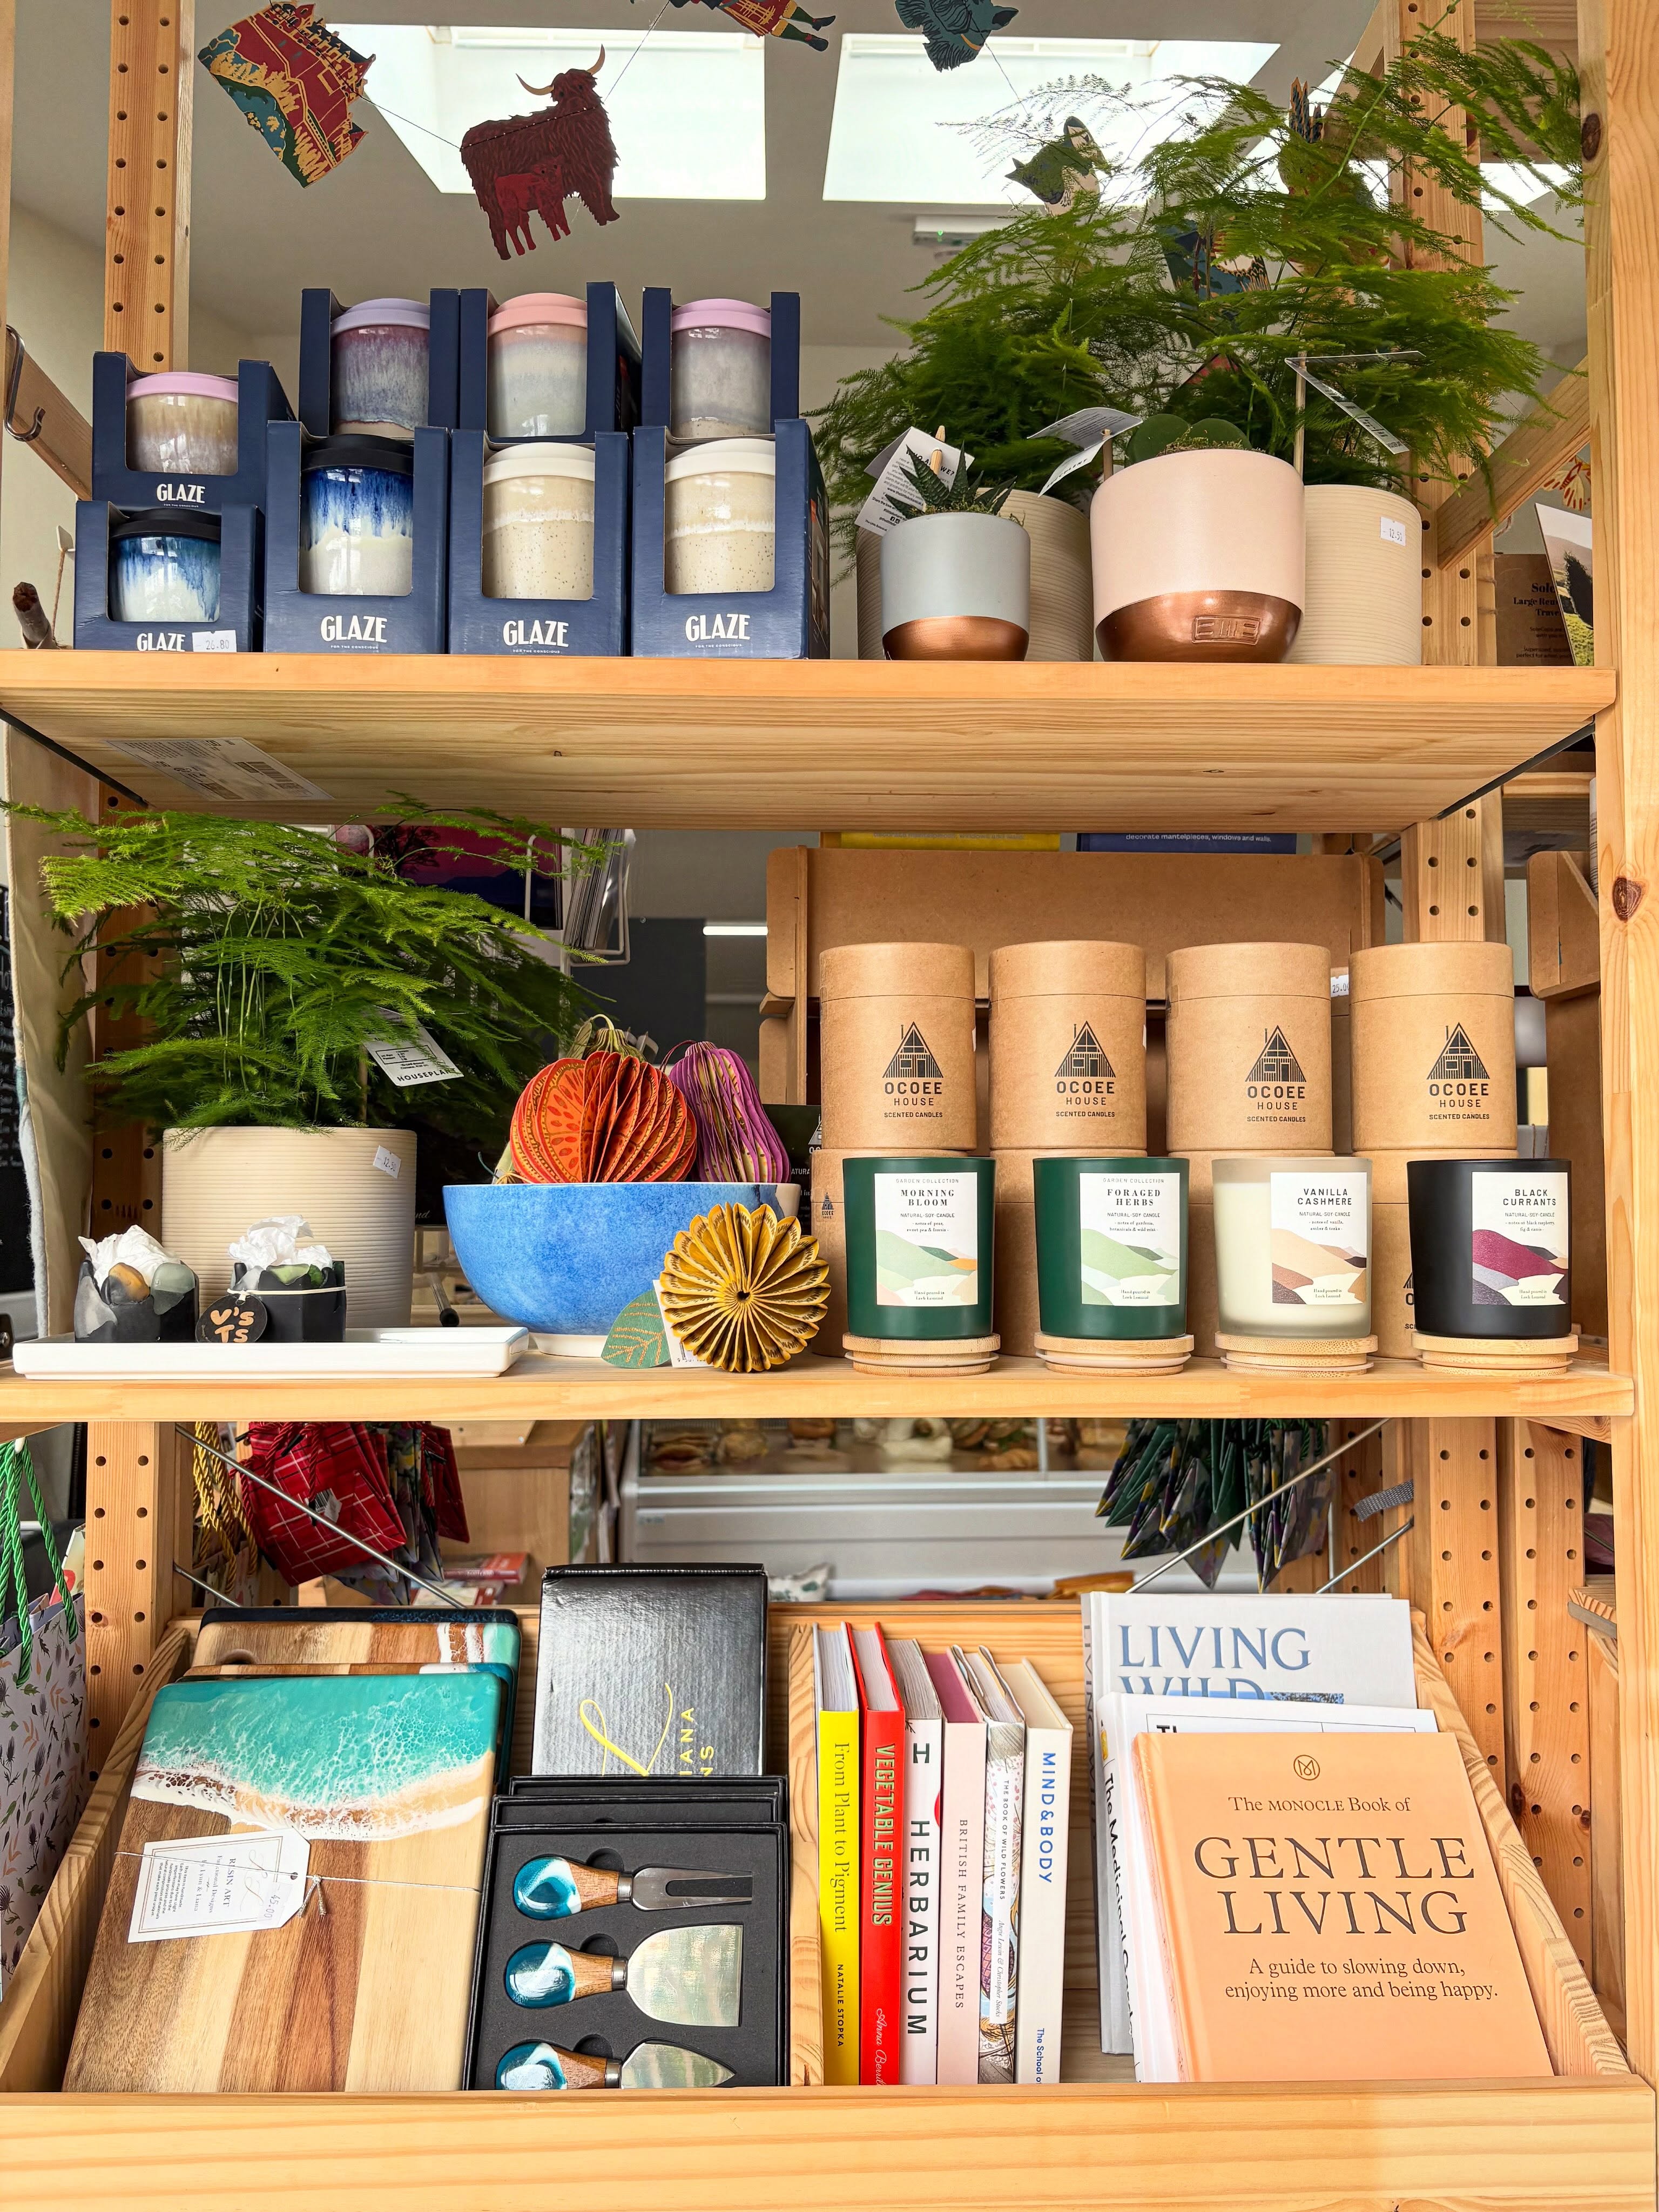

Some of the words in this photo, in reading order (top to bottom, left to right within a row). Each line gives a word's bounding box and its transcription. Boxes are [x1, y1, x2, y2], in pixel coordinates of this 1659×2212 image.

[941, 466, 955, 476] WE?
[157, 483, 206, 503] GLAZE
[1513, 597, 1537, 606] Large
[321, 615, 388, 643] GLAZE
[503, 620, 569, 648] GLAZE
[685, 613, 751, 642] GLAZE
[137, 632, 185, 651] GLAZE
[206, 639, 230, 650] 26.80
[885, 1082, 942, 1095] OCOEE
[1056, 1081, 1115, 1094] OCOEE
[1247, 1086, 1305, 1098] OCOEE
[1429, 1083, 1489, 1096] OCOEE
[894, 1098, 934, 1106] HOUSE
[1066, 1097, 1107, 1105] HOUSE
[1257, 1102, 1298, 1110] HOUSE
[1440, 1100, 1481, 1108] HOUSE
[1107, 1189, 1161, 1197] FORAGED
[1298, 1197, 1352, 1205] CASHMERE
[210, 1306, 254, 1326] V's
[214, 1324, 249, 1343] TS
[1117, 1624, 1312, 1671] LIVING
[678, 1707, 694, 1776] IANA
[834, 1743, 850, 1786] From
[873, 1743, 896, 1851] VEGETABLE
[1105, 1772, 1114, 1814] The
[834, 1792, 850, 1835] Plant
[1229, 1796, 1263, 1811] The
[1267, 1800, 1345, 1811] MONOCLE
[1347, 1797, 1392, 1811] Book
[1395, 1796, 1412, 1811] of
[1002, 1825, 1007, 1835] OF
[834, 1839, 848, 1856] to
[959, 1819, 968, 1877] BRITISH
[1194, 1836, 1475, 1879] GENTLE
[209, 1890, 218, 1913] Designs
[223, 1889, 231, 1907] ART
[830, 1862, 850, 1932] Pigment
[872, 1857, 894, 1926] GENIUS
[264, 1894, 280, 1918] 45.00
[957, 1885, 966, 1938] FAMILY
[1217, 1891, 1467, 1934] LIVING
[907, 1820, 930, 2035] HERBARIUM
[955, 1946, 965, 2008] ESCAPES
[1249, 1959, 1264, 1974] A
[1269, 1959, 1316, 1978] guide
[1320, 1961, 1338, 1974] to
[1343, 1959, 1408, 1978] slowing
[1412, 1959, 1465, 1976] down,
[1225, 1982, 1298, 2001] enjoying
[1303, 1985, 1347, 1998] more
[1352, 1982, 1384, 1998] and
[1388, 1981, 1438, 2000] being
[1440, 1982, 1498, 2000] happy.
[876, 2008, 887, 2046] Anna
[1036, 2046, 1044, 2075] School
